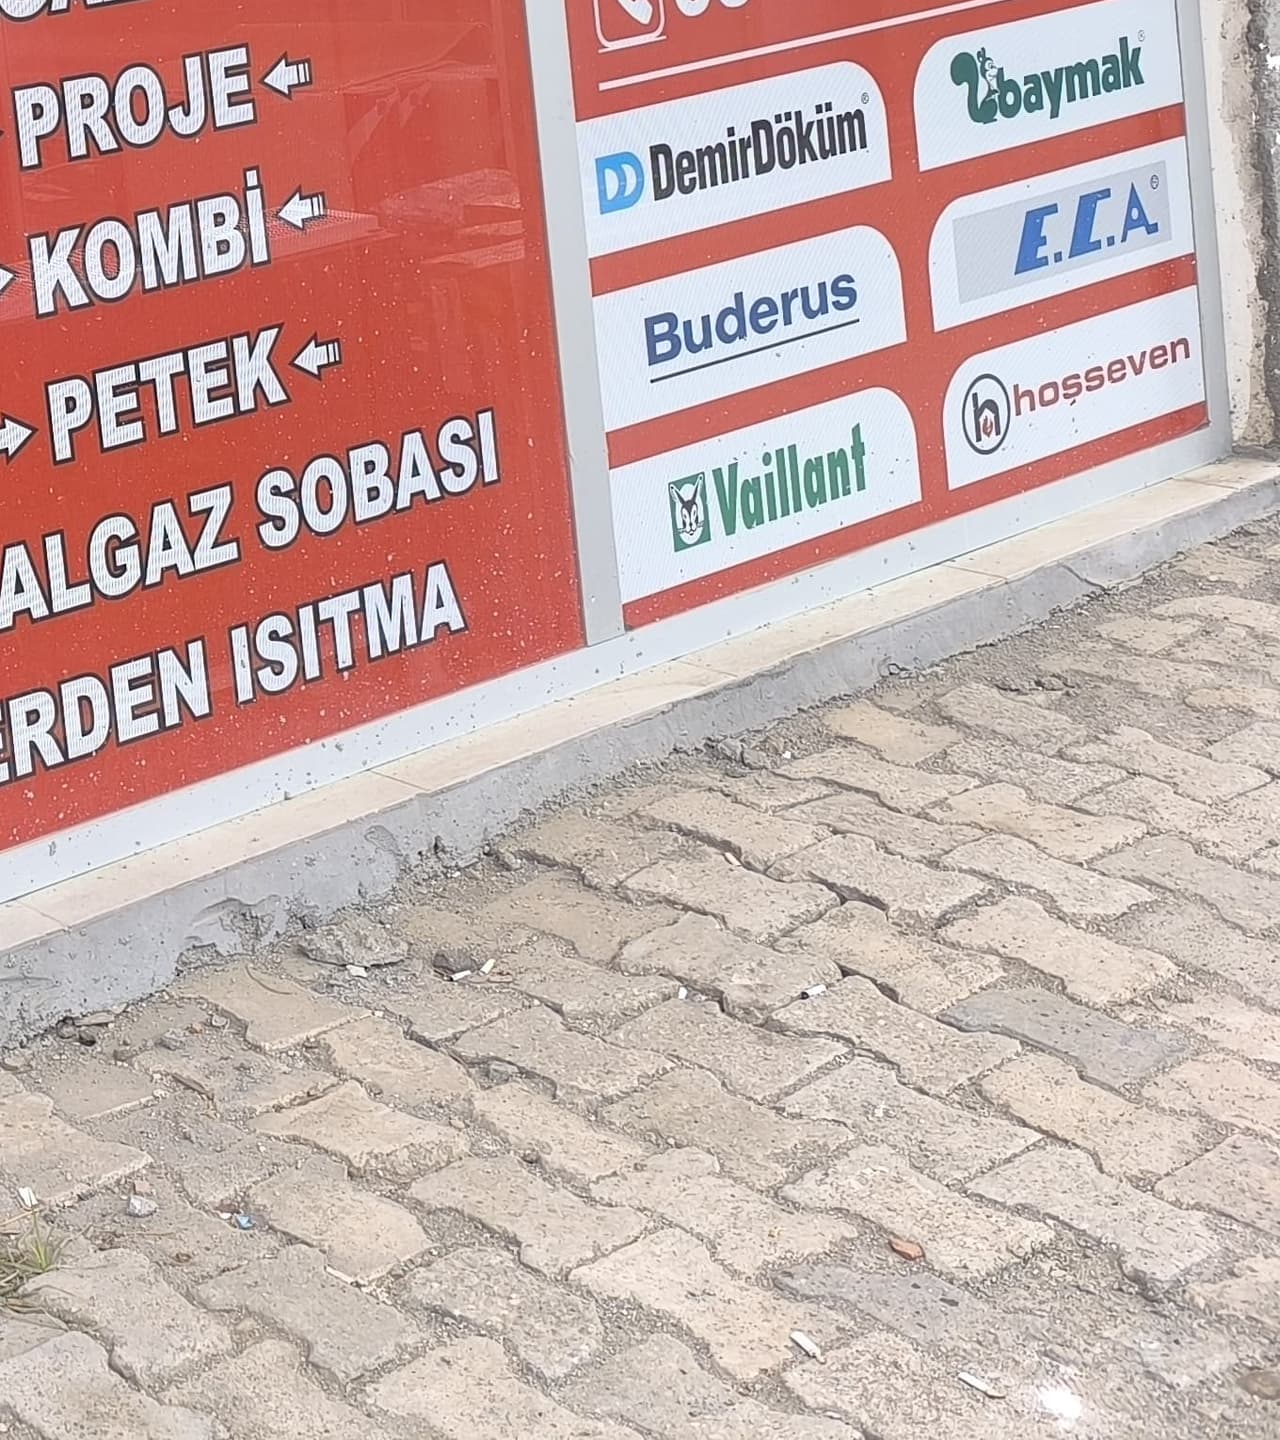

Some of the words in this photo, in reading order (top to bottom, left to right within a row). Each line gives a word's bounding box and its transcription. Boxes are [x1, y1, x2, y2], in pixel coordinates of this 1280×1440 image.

[12, 44, 258, 171] PROJE
[993, 35, 1145, 120] baymak
[649, 100, 869, 204] DemirDöküm
[26, 167, 273, 319] KOMBİ
[643, 271, 860, 367] Buderus
[44, 323, 292, 465] PETEK
[254, 407, 502, 552] SOBASI
[712, 421, 868, 538] Vaillant
[228, 559, 468, 707] ISITMA
